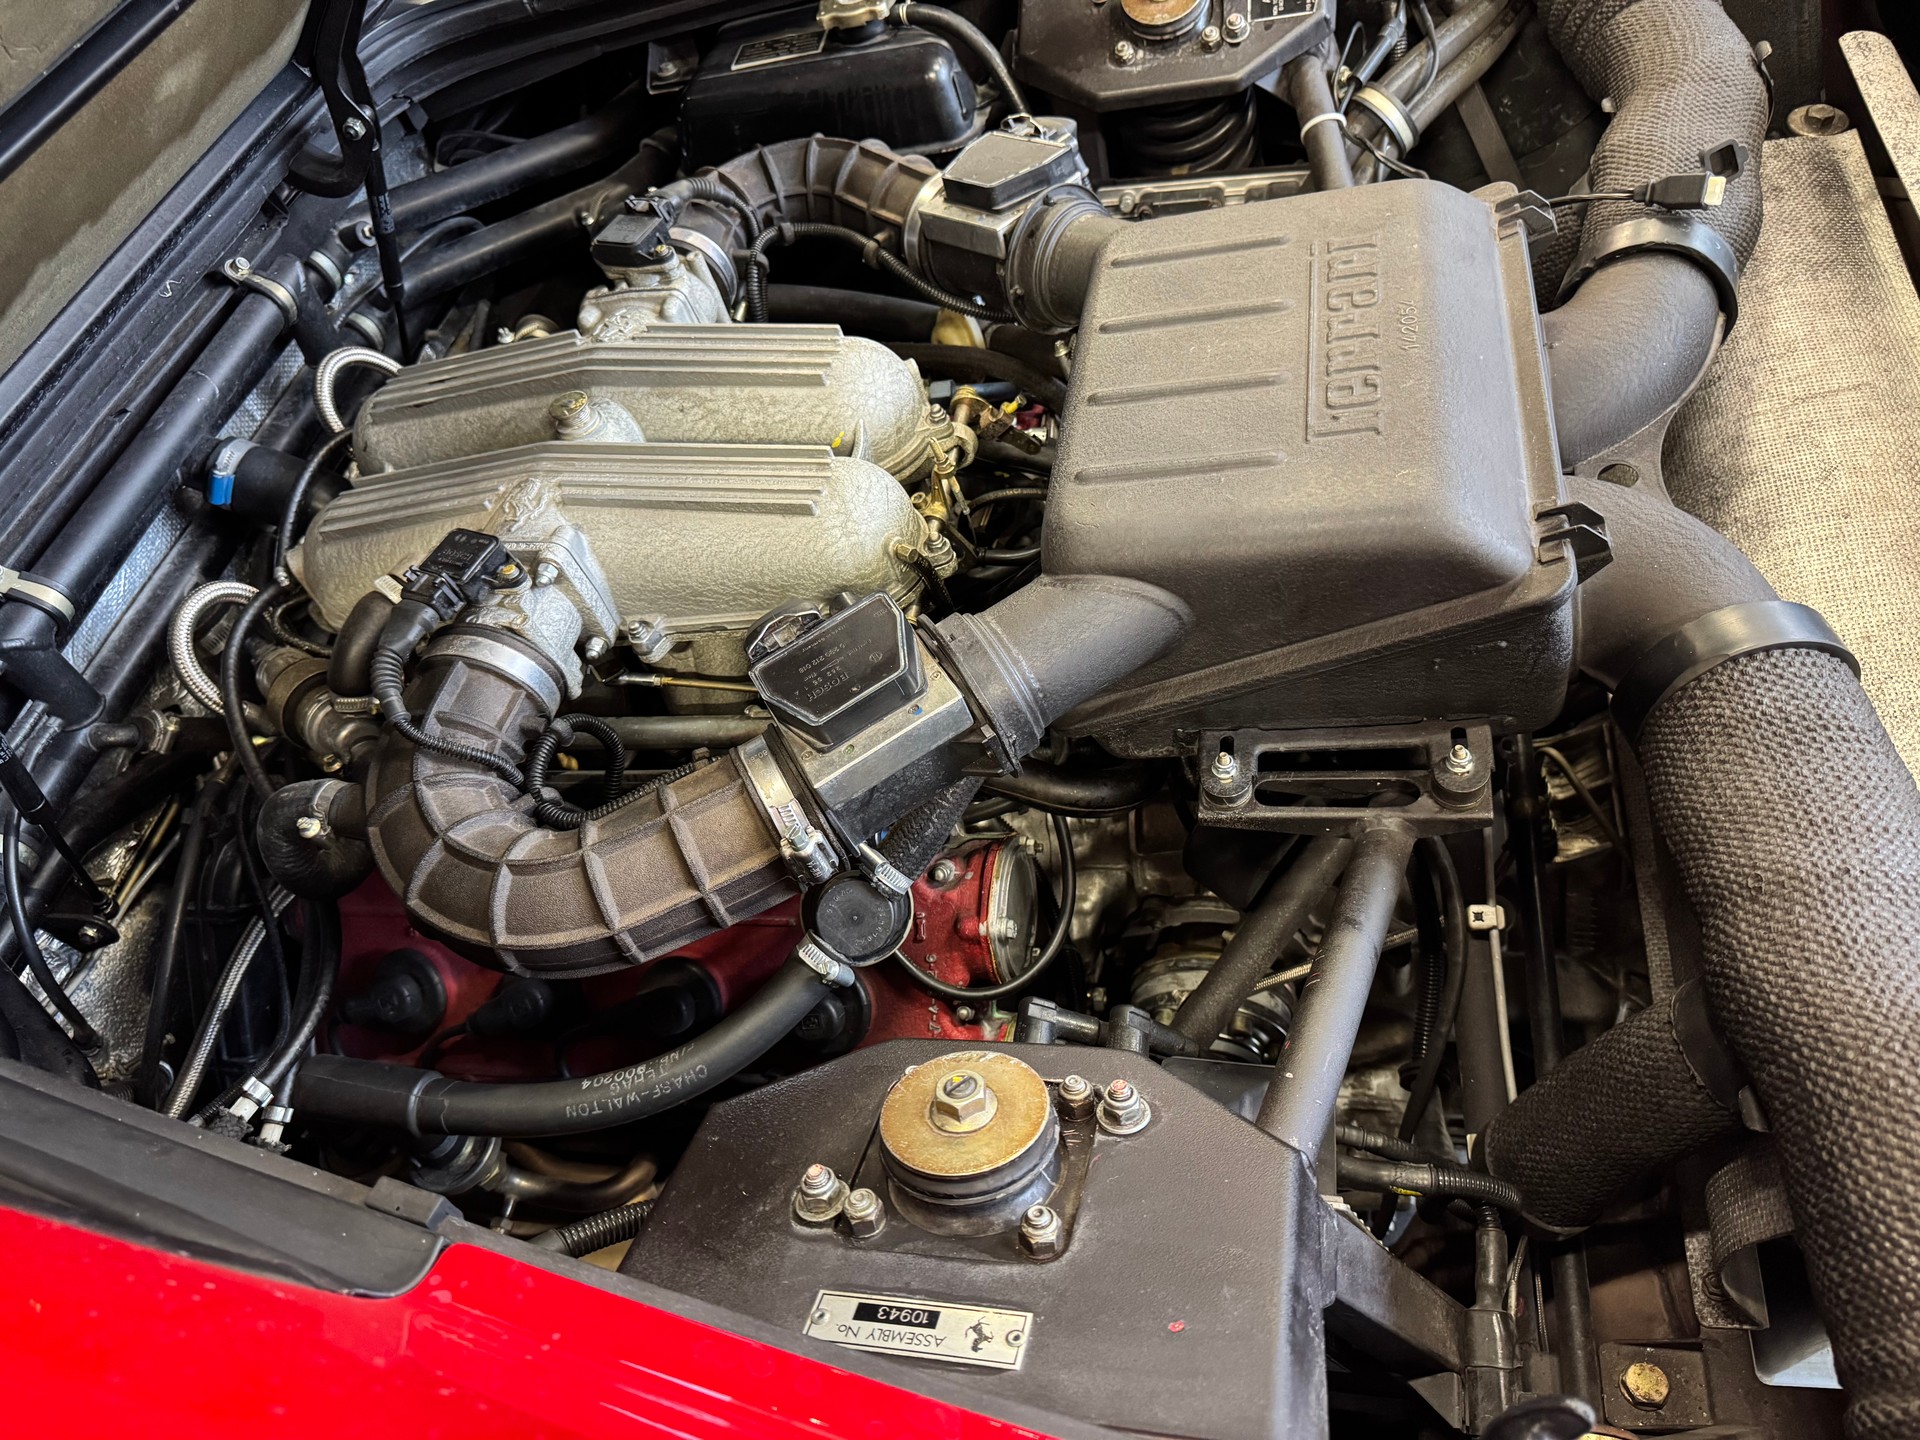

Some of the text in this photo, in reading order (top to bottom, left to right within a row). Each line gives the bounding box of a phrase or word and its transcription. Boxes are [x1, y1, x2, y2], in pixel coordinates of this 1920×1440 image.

[804, 670, 850, 702] BOSCH
[877, 1306, 929, 1324] 10943
[836, 1323, 947, 1347] ASSEMBLY No.
